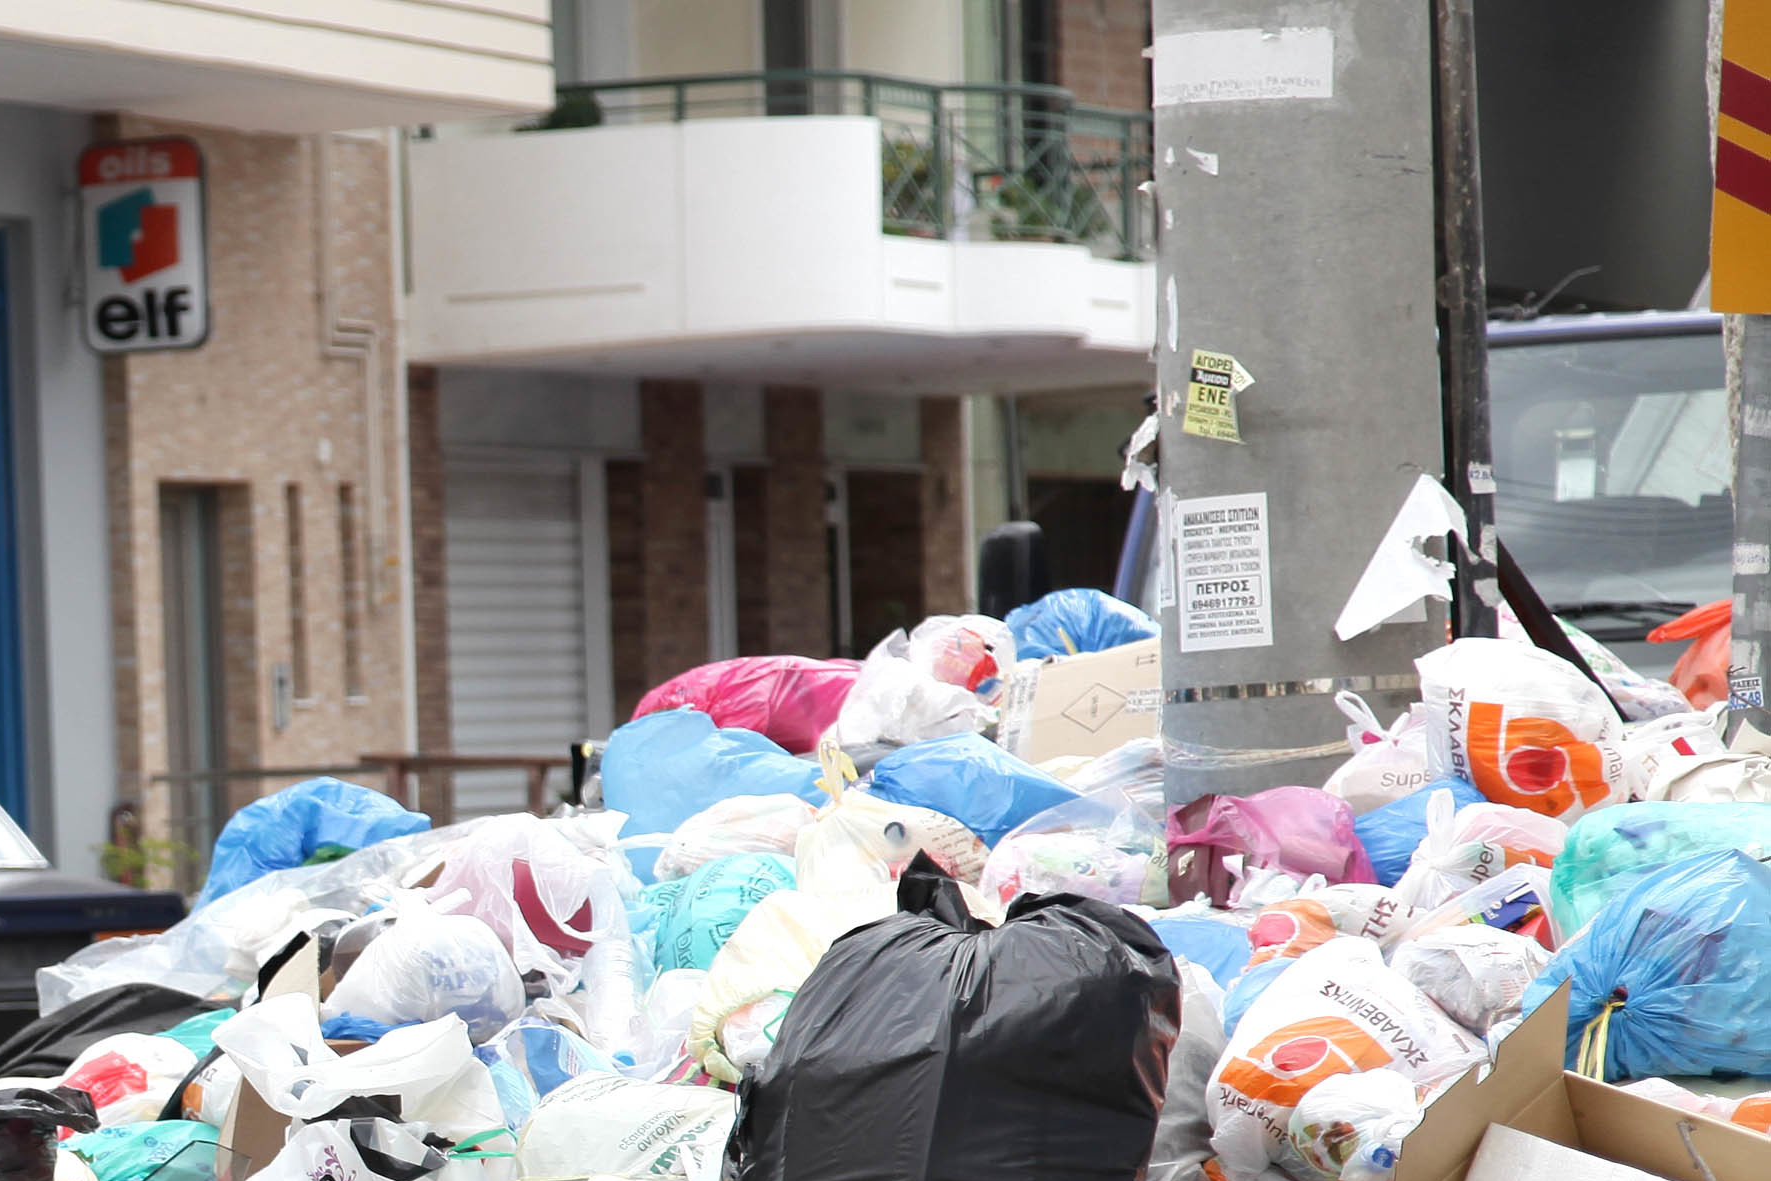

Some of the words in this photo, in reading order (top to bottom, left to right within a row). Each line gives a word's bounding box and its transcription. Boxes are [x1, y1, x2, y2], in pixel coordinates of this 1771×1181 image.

[97, 146, 171, 179] oils
[96, 286, 191, 340] elf
[1192, 595, 1255, 610] 6946917792
[1196, 580, 1250, 595] ΠΕΤΡΟΣ
[1320, 979, 1429, 1069] ΣΚΛΑΒΕΝΙΤΗΣ
